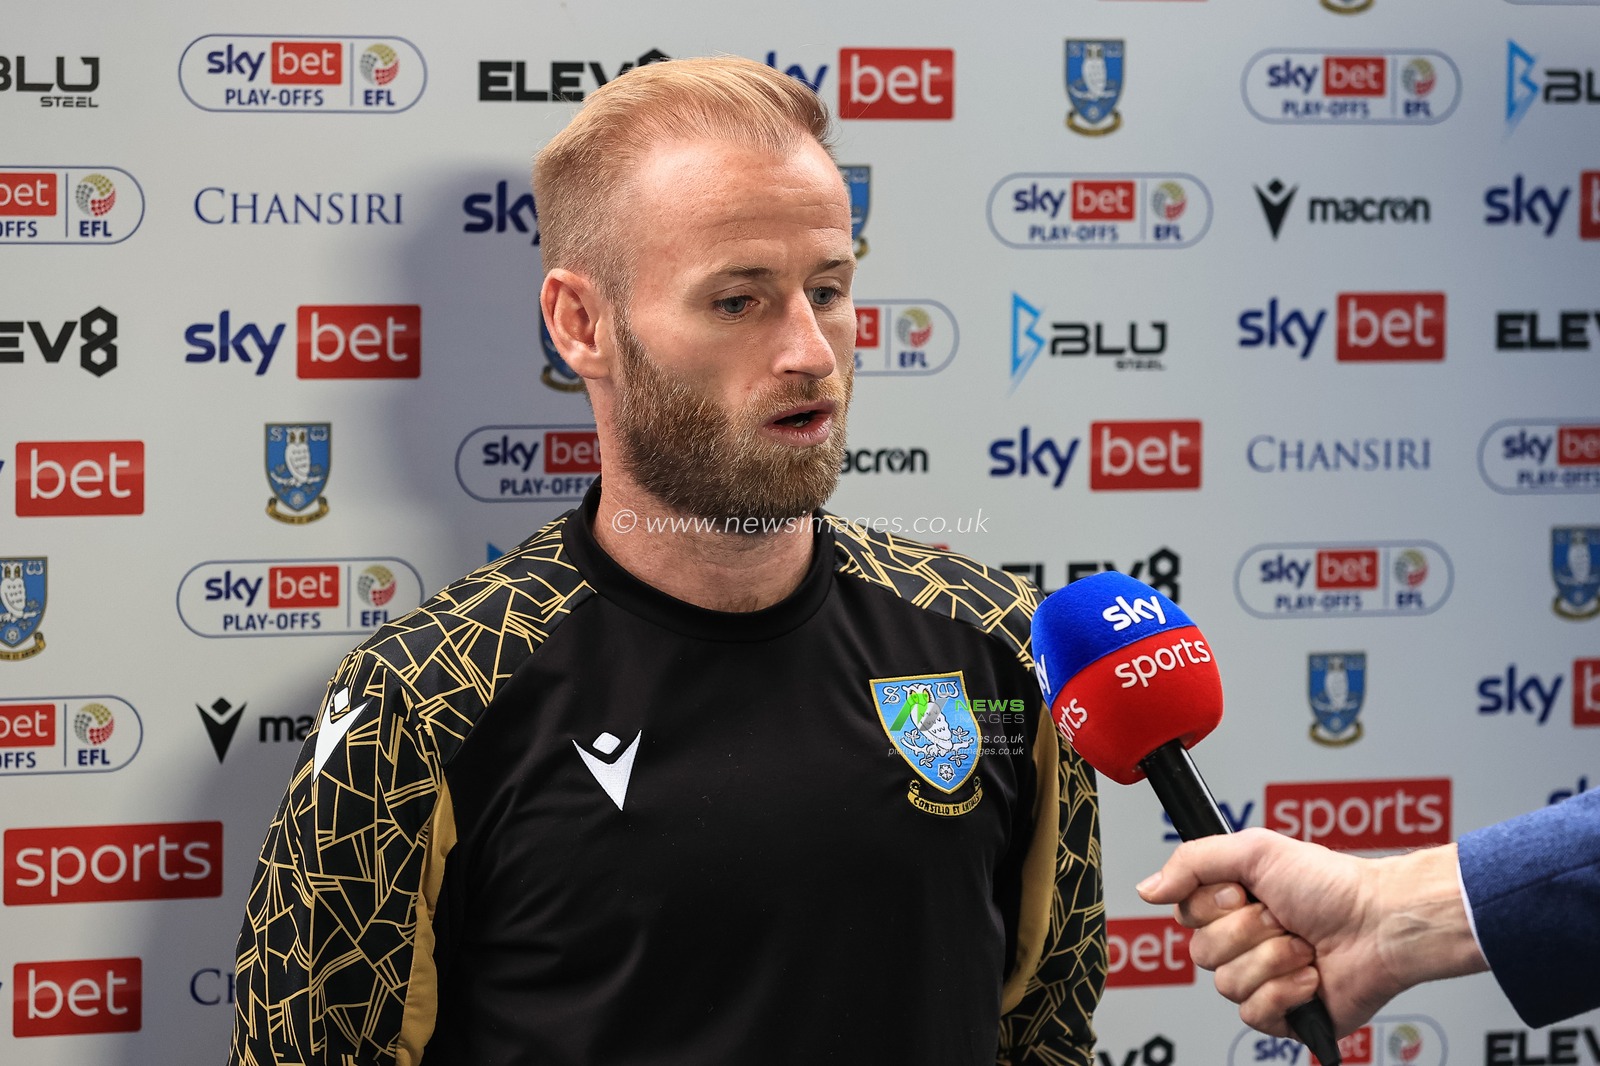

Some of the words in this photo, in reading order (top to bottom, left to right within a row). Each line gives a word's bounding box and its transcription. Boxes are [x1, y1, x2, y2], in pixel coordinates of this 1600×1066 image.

[207, 43, 266, 82] sky
[278, 46, 336, 76] bet
[850, 54, 944, 104] bet
[1267, 58, 1319, 94] sky
[1328, 59, 1382, 89] bet
[40, 96, 99, 108] STEEL
[225, 89, 324, 106] PLAY-OFFS
[364, 90, 396, 106] EFL
[1013, 183, 1067, 219] sky
[1076, 186, 1130, 213] bet
[1308, 196, 1431, 225] macron
[1484, 174, 1570, 238] sky
[79, 221, 112, 238] EFL
[1030, 225, 1119, 242] PLAY-OFFS
[1154, 224, 1183, 242] EFL
[184, 310, 286, 376] sky
[310, 312, 409, 363] bet
[1050, 320, 1168, 357] BLU
[1238, 295, 1328, 361] sky
[1347, 298, 1436, 348] bet
[482, 435, 540, 472] sky
[988, 425, 1081, 489] sky
[1100, 427, 1192, 478] bet
[1503, 429, 1553, 466] sky
[30, 449, 131, 500] bet
[205, 570, 263, 607] sky
[276, 571, 333, 601] bet
[1259, 555, 1312, 589] sky
[1320, 555, 1374, 585] bet
[223, 612, 322, 631] PLAY-OFFS
[1102, 595, 1167, 632] sky
[1114, 638, 1211, 688] sports
[1478, 663, 1563, 726] sky
[77, 748, 110, 766] EFL
[1272, 788, 1444, 842] sports
[16, 835, 212, 897] sports
[28, 968, 129, 1020] bet
